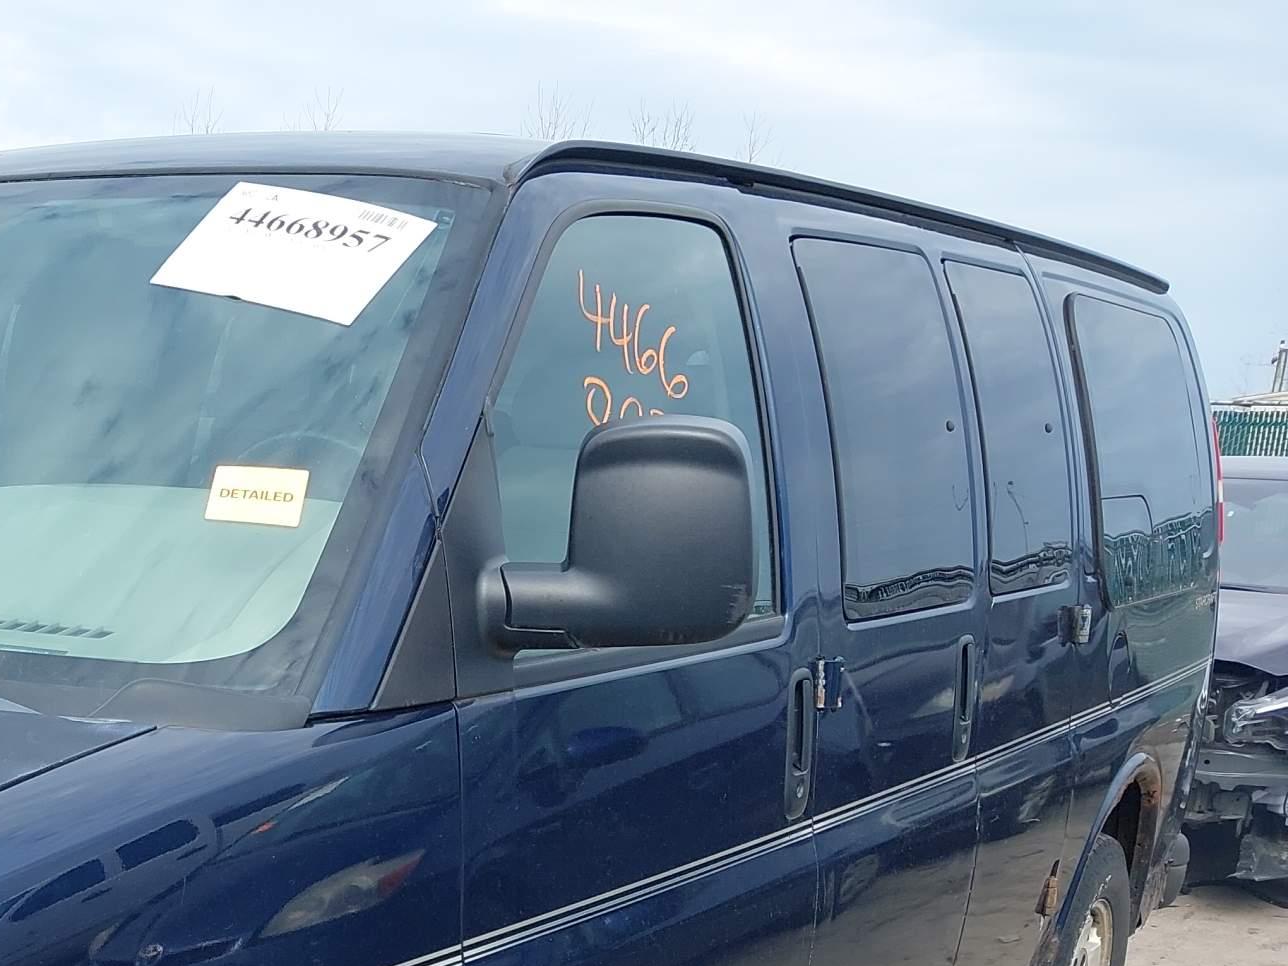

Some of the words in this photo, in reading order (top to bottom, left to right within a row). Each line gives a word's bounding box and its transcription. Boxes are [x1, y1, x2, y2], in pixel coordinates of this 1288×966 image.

[228, 207, 393, 253] 44668957
[577, 268, 689, 400] 4466
[219, 487, 294, 503] DETAILED
